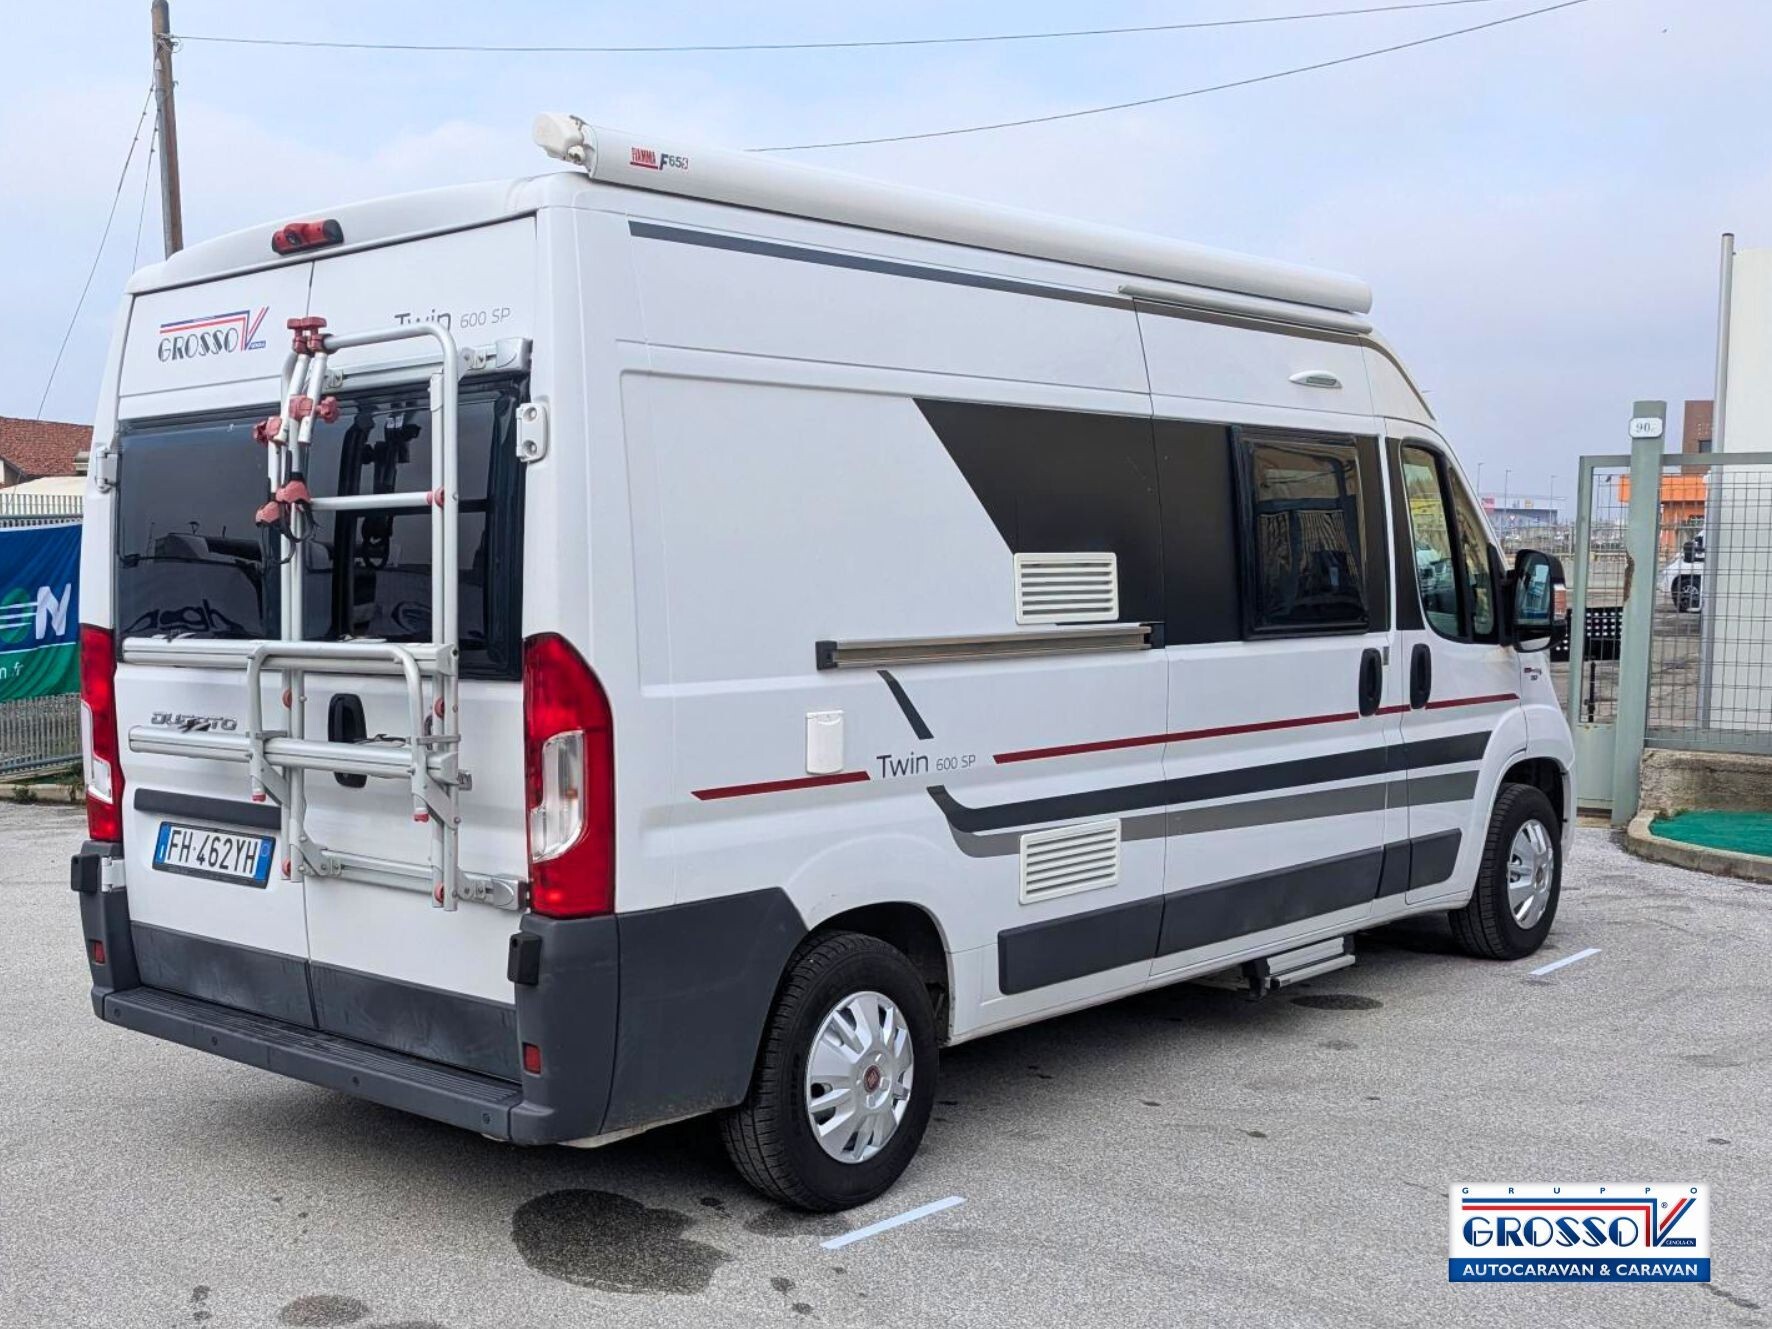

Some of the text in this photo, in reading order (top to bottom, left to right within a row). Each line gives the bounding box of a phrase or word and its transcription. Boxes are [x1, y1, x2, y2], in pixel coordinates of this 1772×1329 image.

[460, 310, 487, 329] 600
[491, 306, 511, 324] SP
[157, 327, 239, 362] GROSSO
[876, 751, 976, 779] Twin 600 SP
